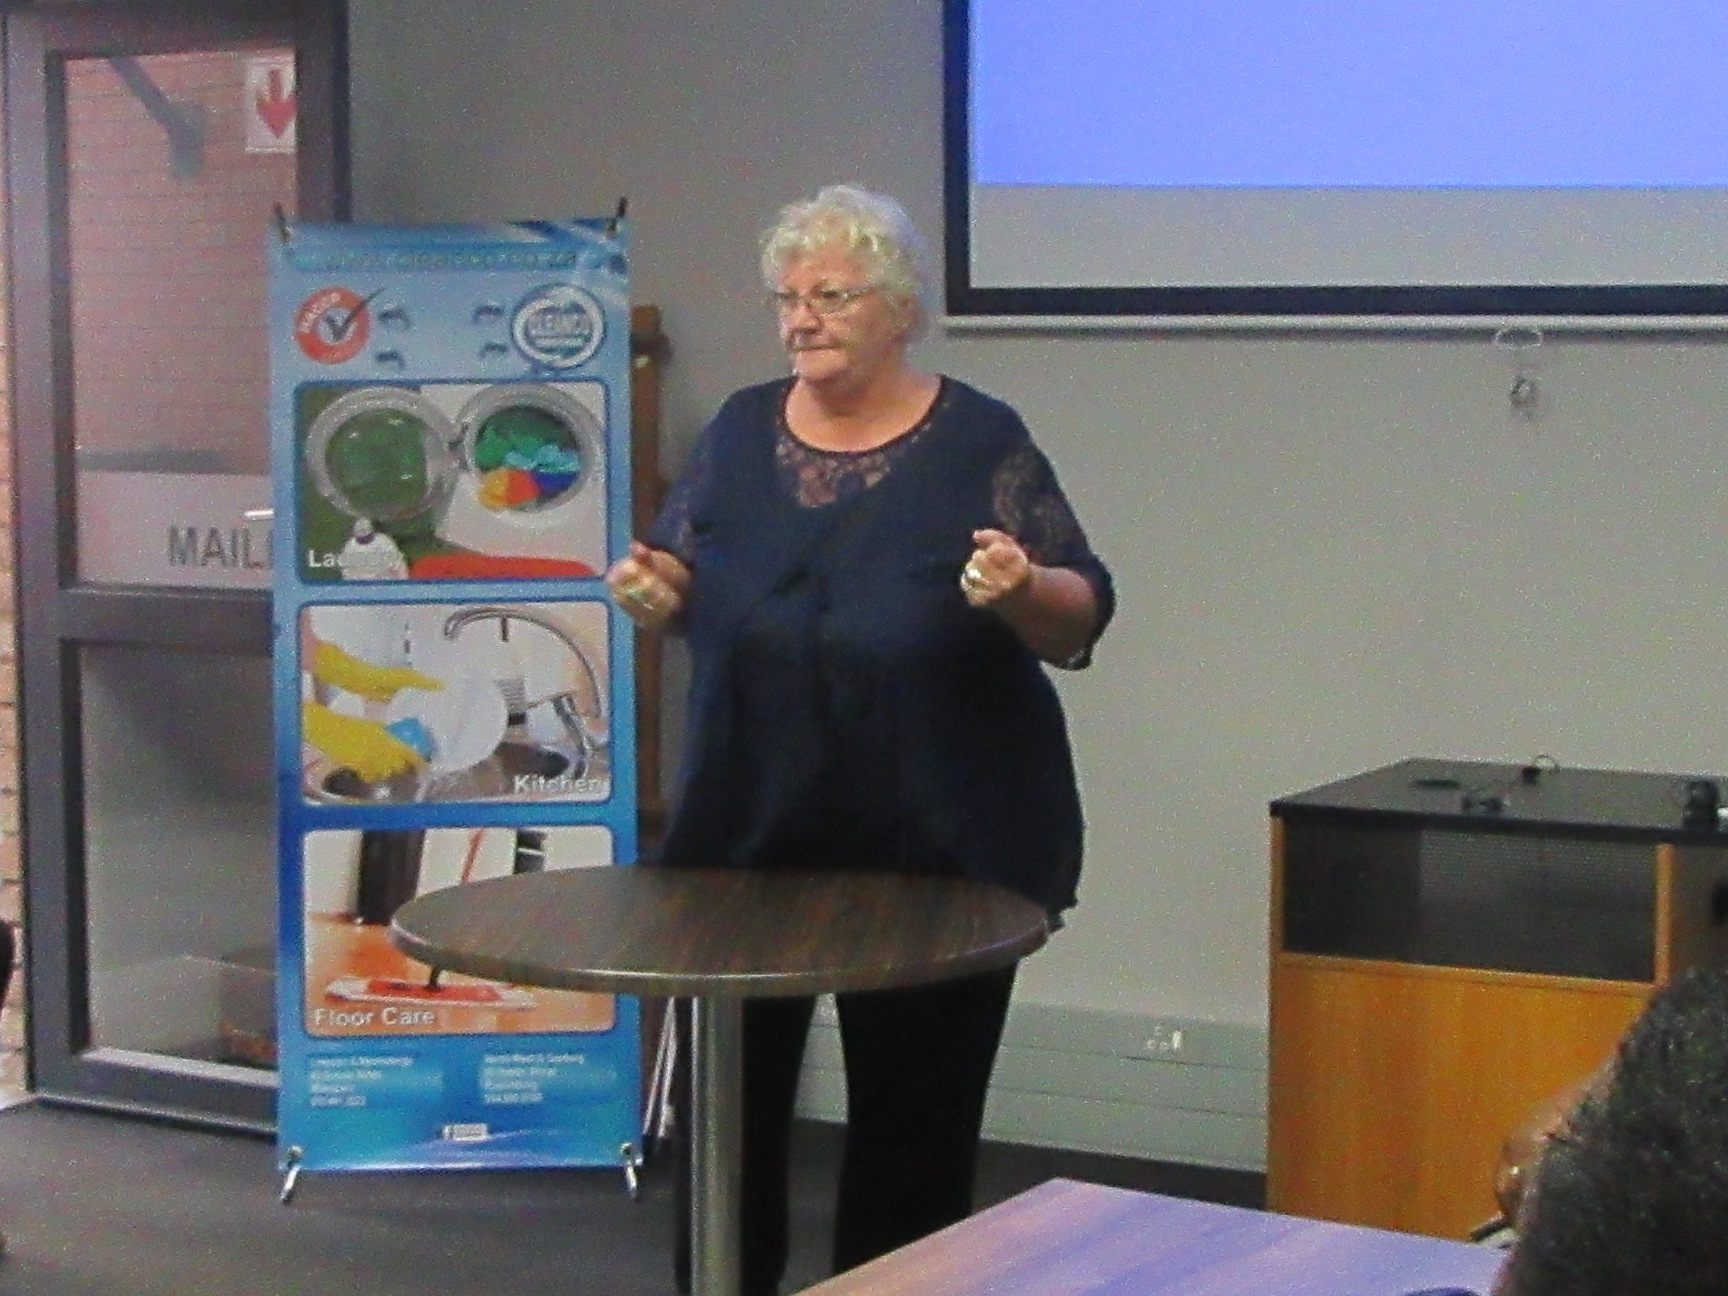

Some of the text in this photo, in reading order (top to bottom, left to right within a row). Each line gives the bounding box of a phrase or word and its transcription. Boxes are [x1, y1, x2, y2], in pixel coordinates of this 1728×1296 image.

[169, 525, 274, 569] MAIL
[313, 1006, 436, 1026] Floor Care
